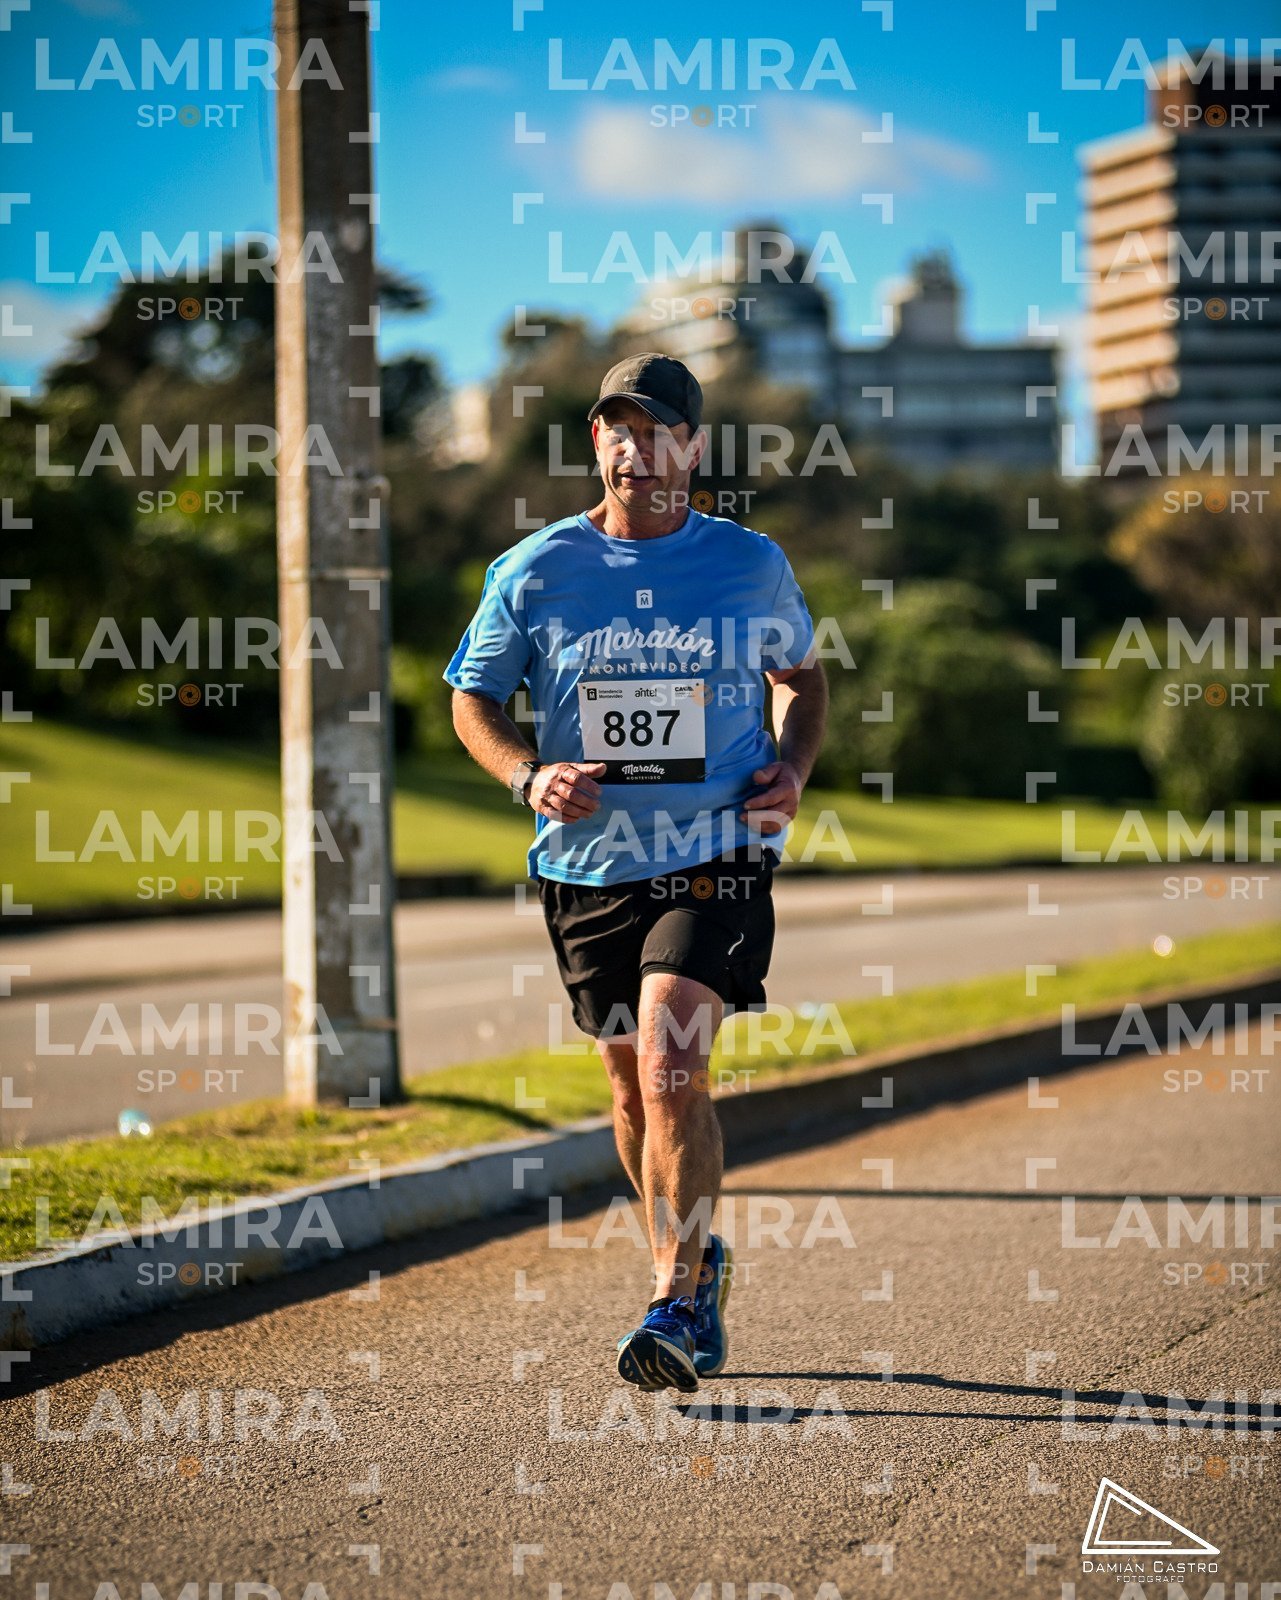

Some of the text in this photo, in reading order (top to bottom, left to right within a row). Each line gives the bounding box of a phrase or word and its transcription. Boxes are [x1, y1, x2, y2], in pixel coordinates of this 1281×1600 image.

[576, 625, 716, 659] Maratón
[590, 662, 701, 674] MONTEVIDEO
[603, 710, 680, 747] 887
